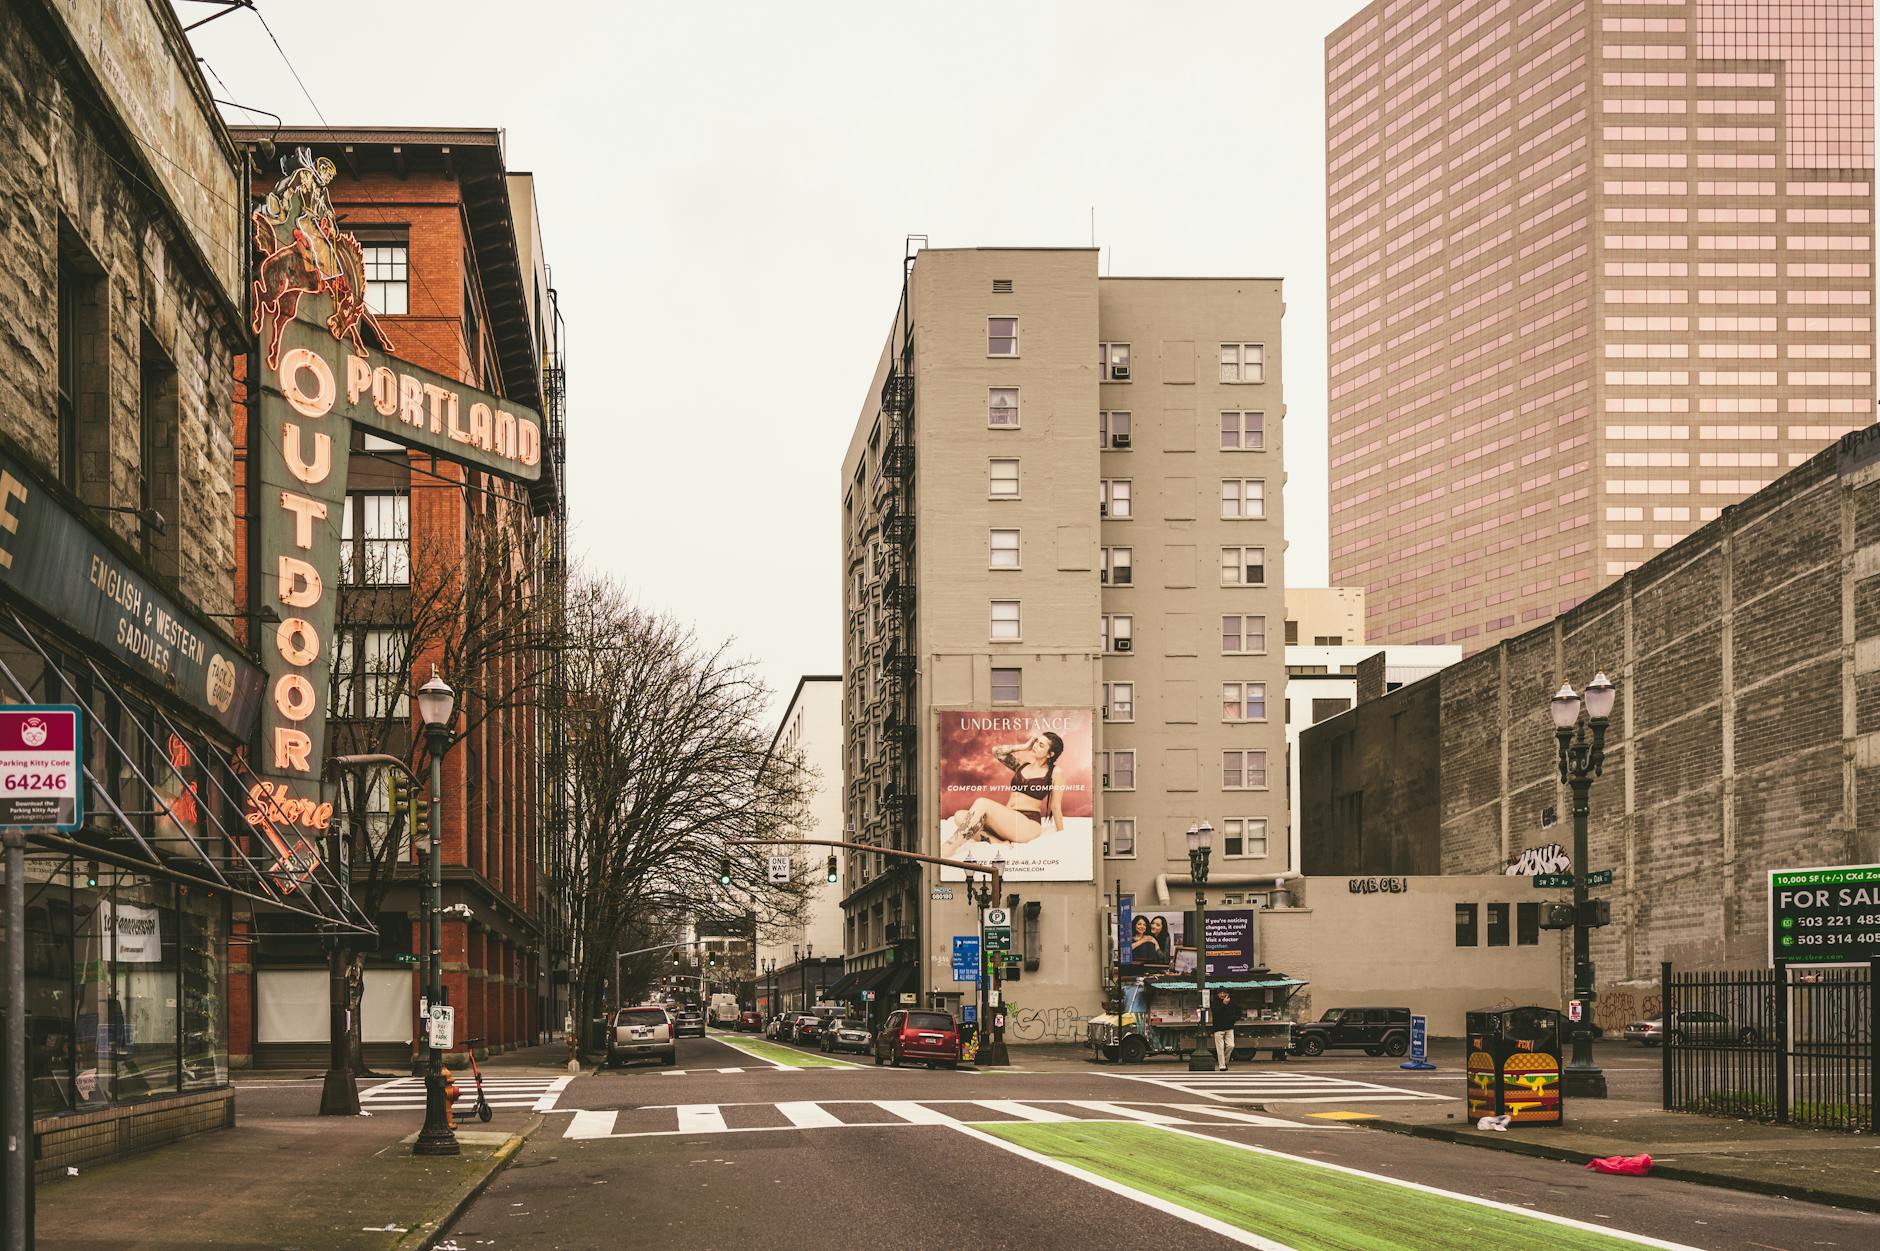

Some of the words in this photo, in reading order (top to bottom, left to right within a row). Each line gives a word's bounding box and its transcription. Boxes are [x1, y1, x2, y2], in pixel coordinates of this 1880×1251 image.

[347, 354, 541, 466] PORTLAND
[274, 348, 336, 772] OUTDOOR
[89, 554, 142, 618] ENGLISH
[144, 601, 153, 627] &
[156, 607, 206, 666] WESTERN
[116, 617, 171, 674] SADDLES
[961, 717, 1072, 731] UNDERSTANCE
[0, 760, 28, 768] Parking
[30, 760, 49, 768] Kitty
[5, 773, 67, 791] 64246
[947, 784, 988, 792] COMFORT
[990, 784, 1029, 792] WITHOUT
[1030, 784, 1086, 792] COMPROMISE
[10, 807, 31, 815] Parking
[246, 781, 334, 830] Store
[1777, 875, 1807, 884] 10,000
[1808, 875, 1820, 883] SF
[1821, 874, 1844, 883] (+/-)
[1845, 872, 1864, 881] CXd
[1780, 890, 1831, 909] FOR
[1826, 915, 1852, 926] 221
[1798, 935, 1823, 945] 503
[1827, 934, 1853, 945] 314
